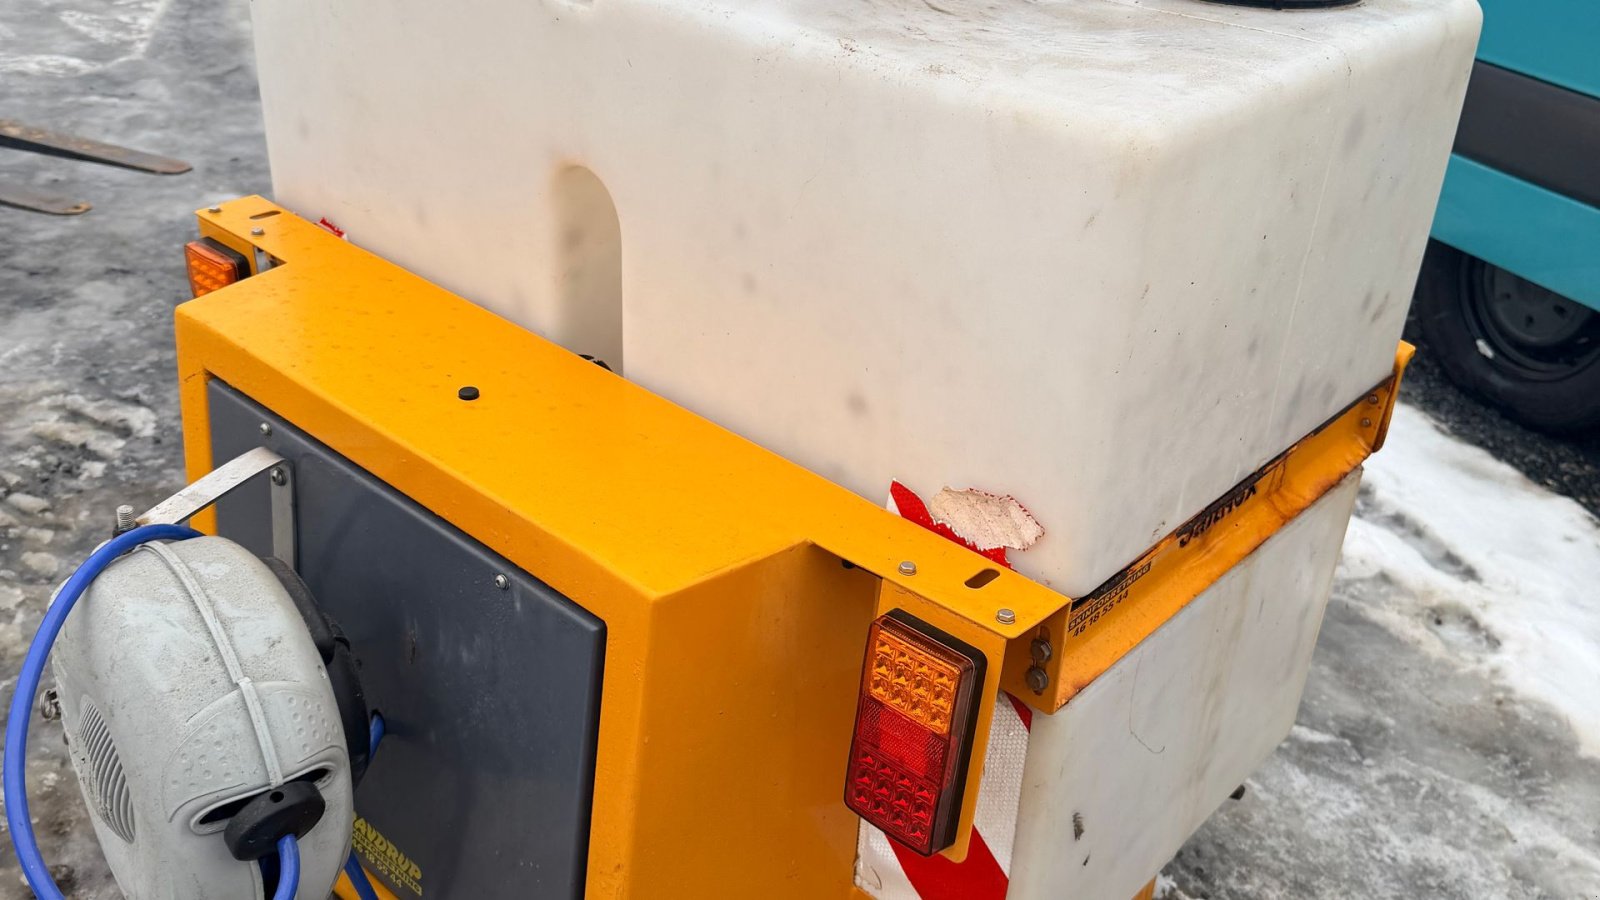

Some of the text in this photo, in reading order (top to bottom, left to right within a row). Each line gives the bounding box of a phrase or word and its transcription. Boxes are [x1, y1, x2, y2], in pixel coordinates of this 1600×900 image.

[1073, 589, 1128, 637] 46 18 55 44
[353, 810, 422, 879] AVDRUP
